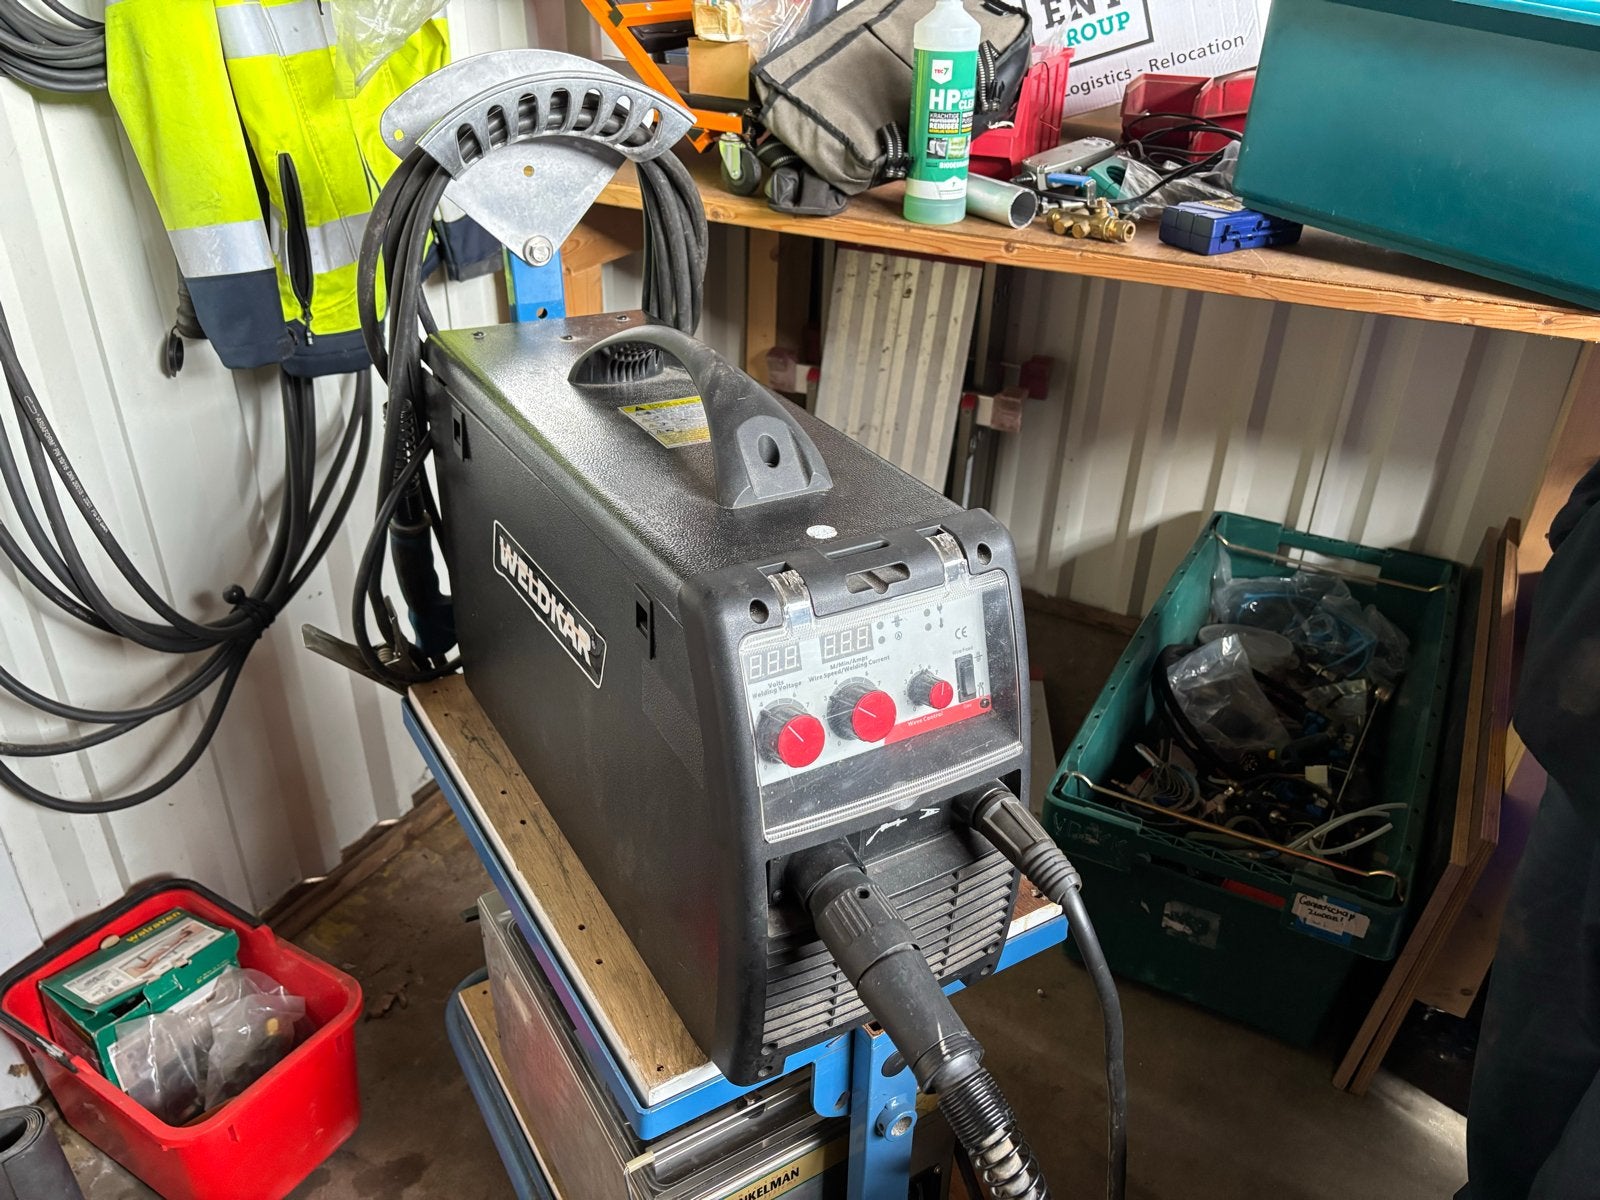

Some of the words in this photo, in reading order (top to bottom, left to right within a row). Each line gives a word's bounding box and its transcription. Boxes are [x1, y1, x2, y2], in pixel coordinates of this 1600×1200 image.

[1040, 0, 1131, 29] EN
[1066, 11, 1130, 47] ROUP
[1148, 34, 1245, 73] Relocation
[929, 88, 961, 111] HP
[499, 535, 592, 667] WELDKAR
[808, 673, 823, 683] Wire
[868, 655, 890, 666] Current
[767, 680, 785, 689] Volts
[778, 681, 802, 692] Voltage
